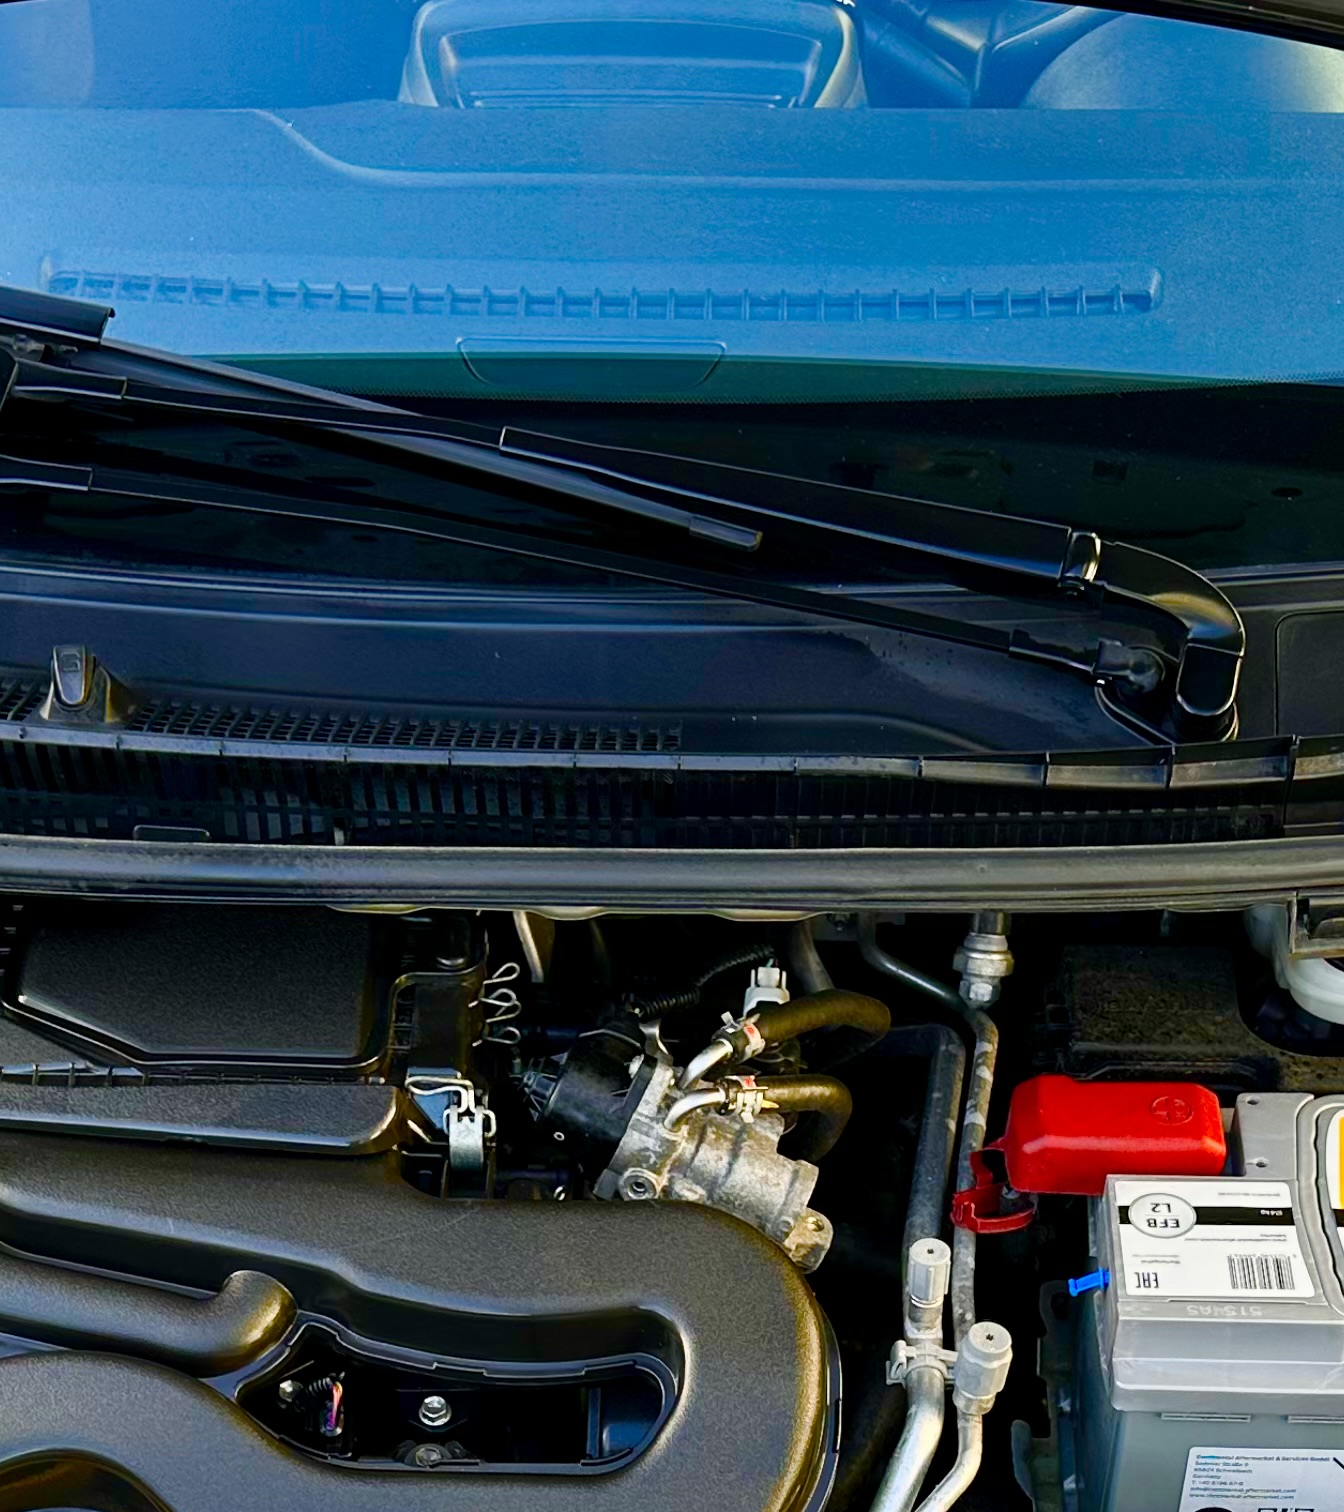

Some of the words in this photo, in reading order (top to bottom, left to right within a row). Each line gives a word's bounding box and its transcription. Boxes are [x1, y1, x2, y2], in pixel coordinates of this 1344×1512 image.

[1150, 1202, 1171, 1213] L2
[1146, 1217, 1180, 1228] EFB
[1134, 1271, 1160, 1289] EAC
